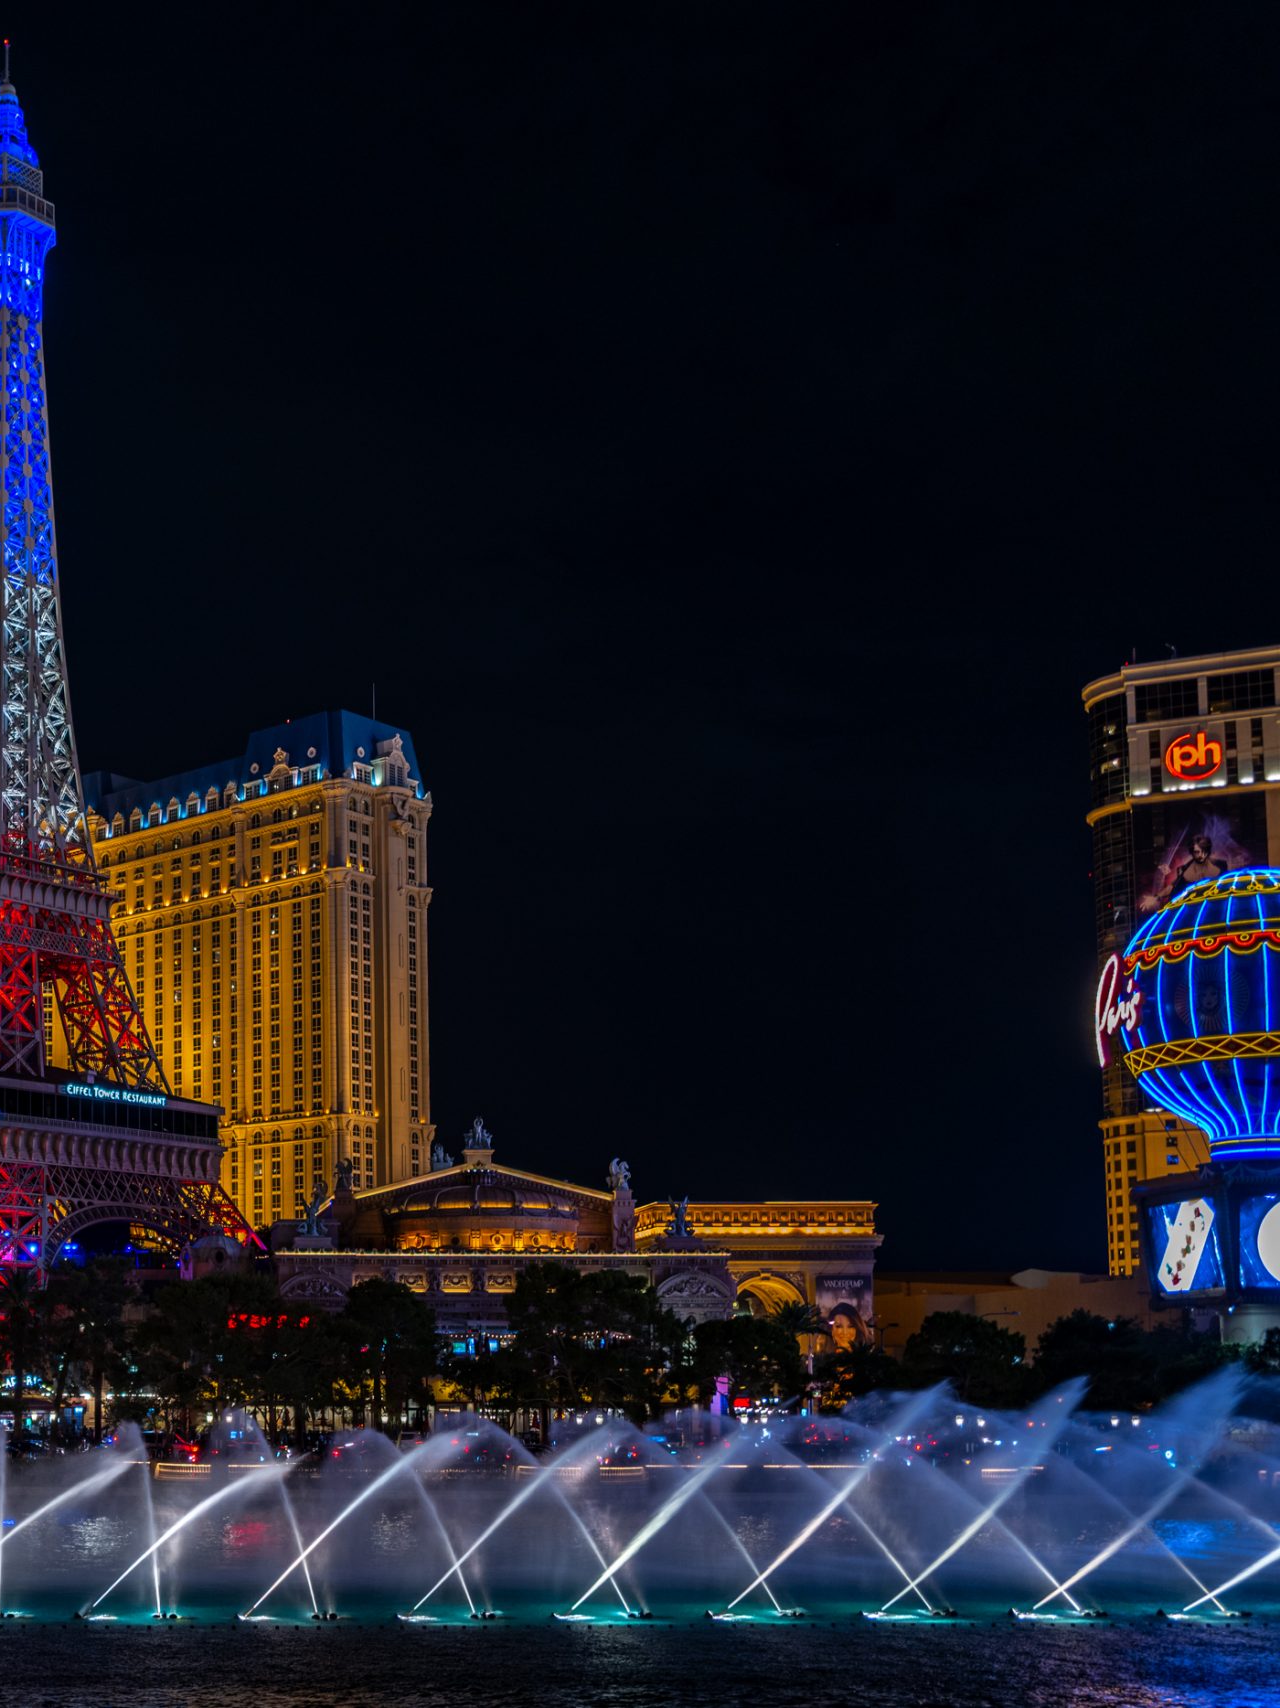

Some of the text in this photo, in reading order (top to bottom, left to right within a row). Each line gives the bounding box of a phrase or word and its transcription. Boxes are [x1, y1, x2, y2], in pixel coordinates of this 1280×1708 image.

[1172, 731, 1221, 774] ph
[1095, 954, 1140, 1068] Paris
[66, 1083, 166, 1106] EIFFEL TOWER RESTAURANT
[823, 1279, 864, 1290] VANDERPUMP
